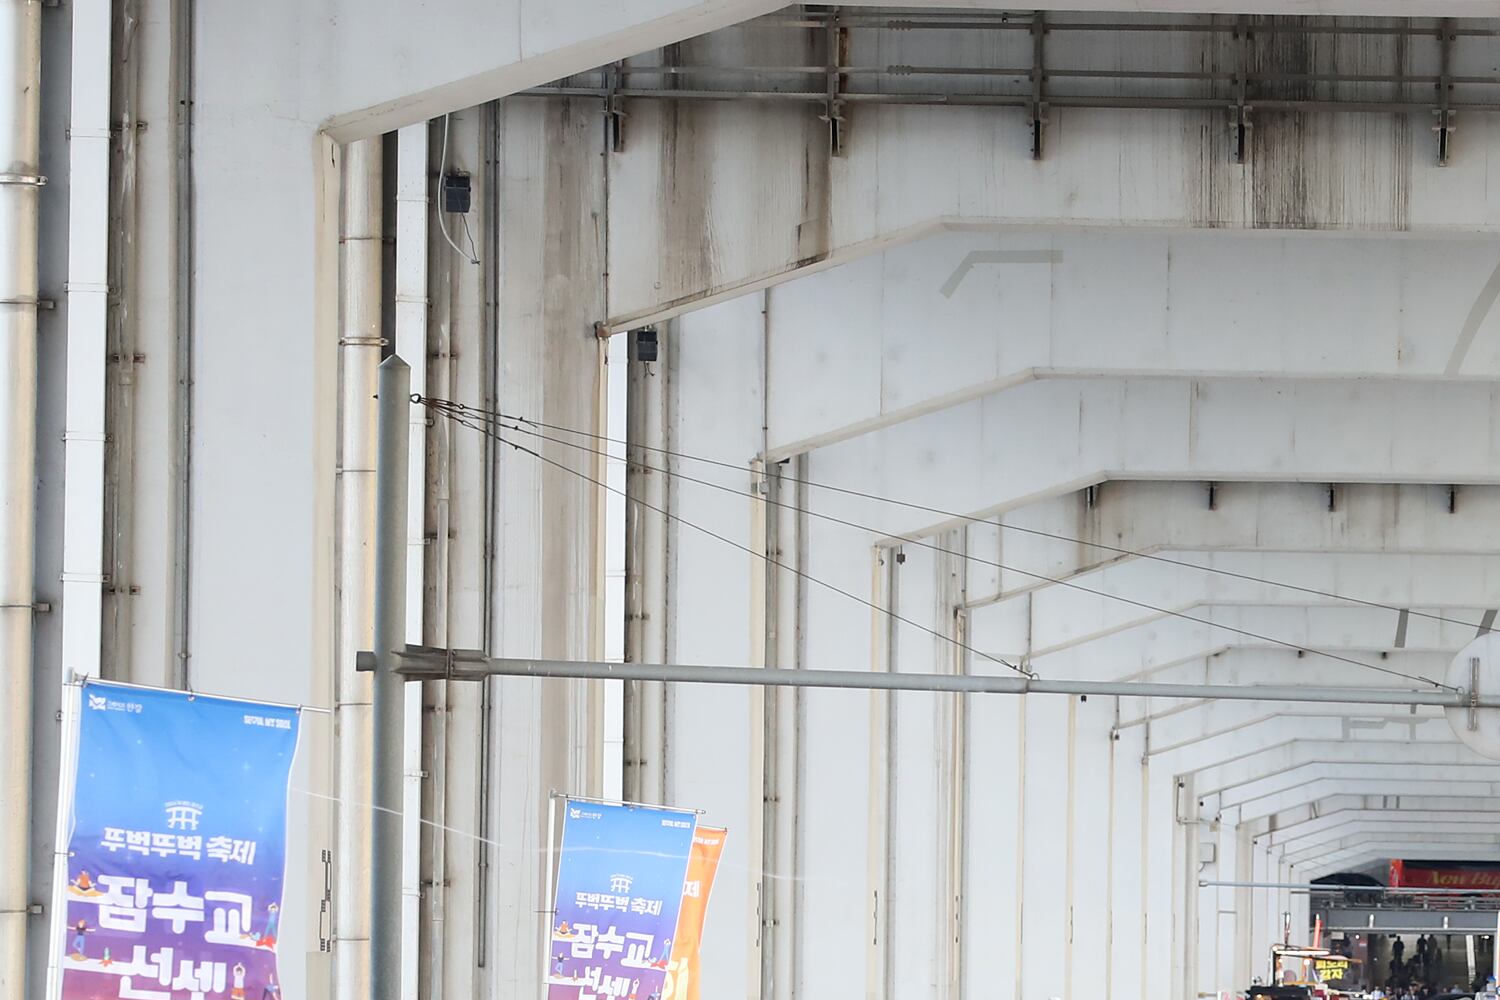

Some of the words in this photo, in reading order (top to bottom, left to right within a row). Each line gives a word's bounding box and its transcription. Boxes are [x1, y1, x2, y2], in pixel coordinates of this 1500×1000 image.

[100, 827, 202, 861] 뚜벅뚜벅
[206, 835, 257, 865] 축제
[97, 874, 253, 944] 잠수교
[575, 891, 630, 913] 뚜벅뚜벅
[631, 897, 663, 917] 축제
[570, 922, 655, 970] 잠수교
[1319, 969, 1344, 980] 감자
